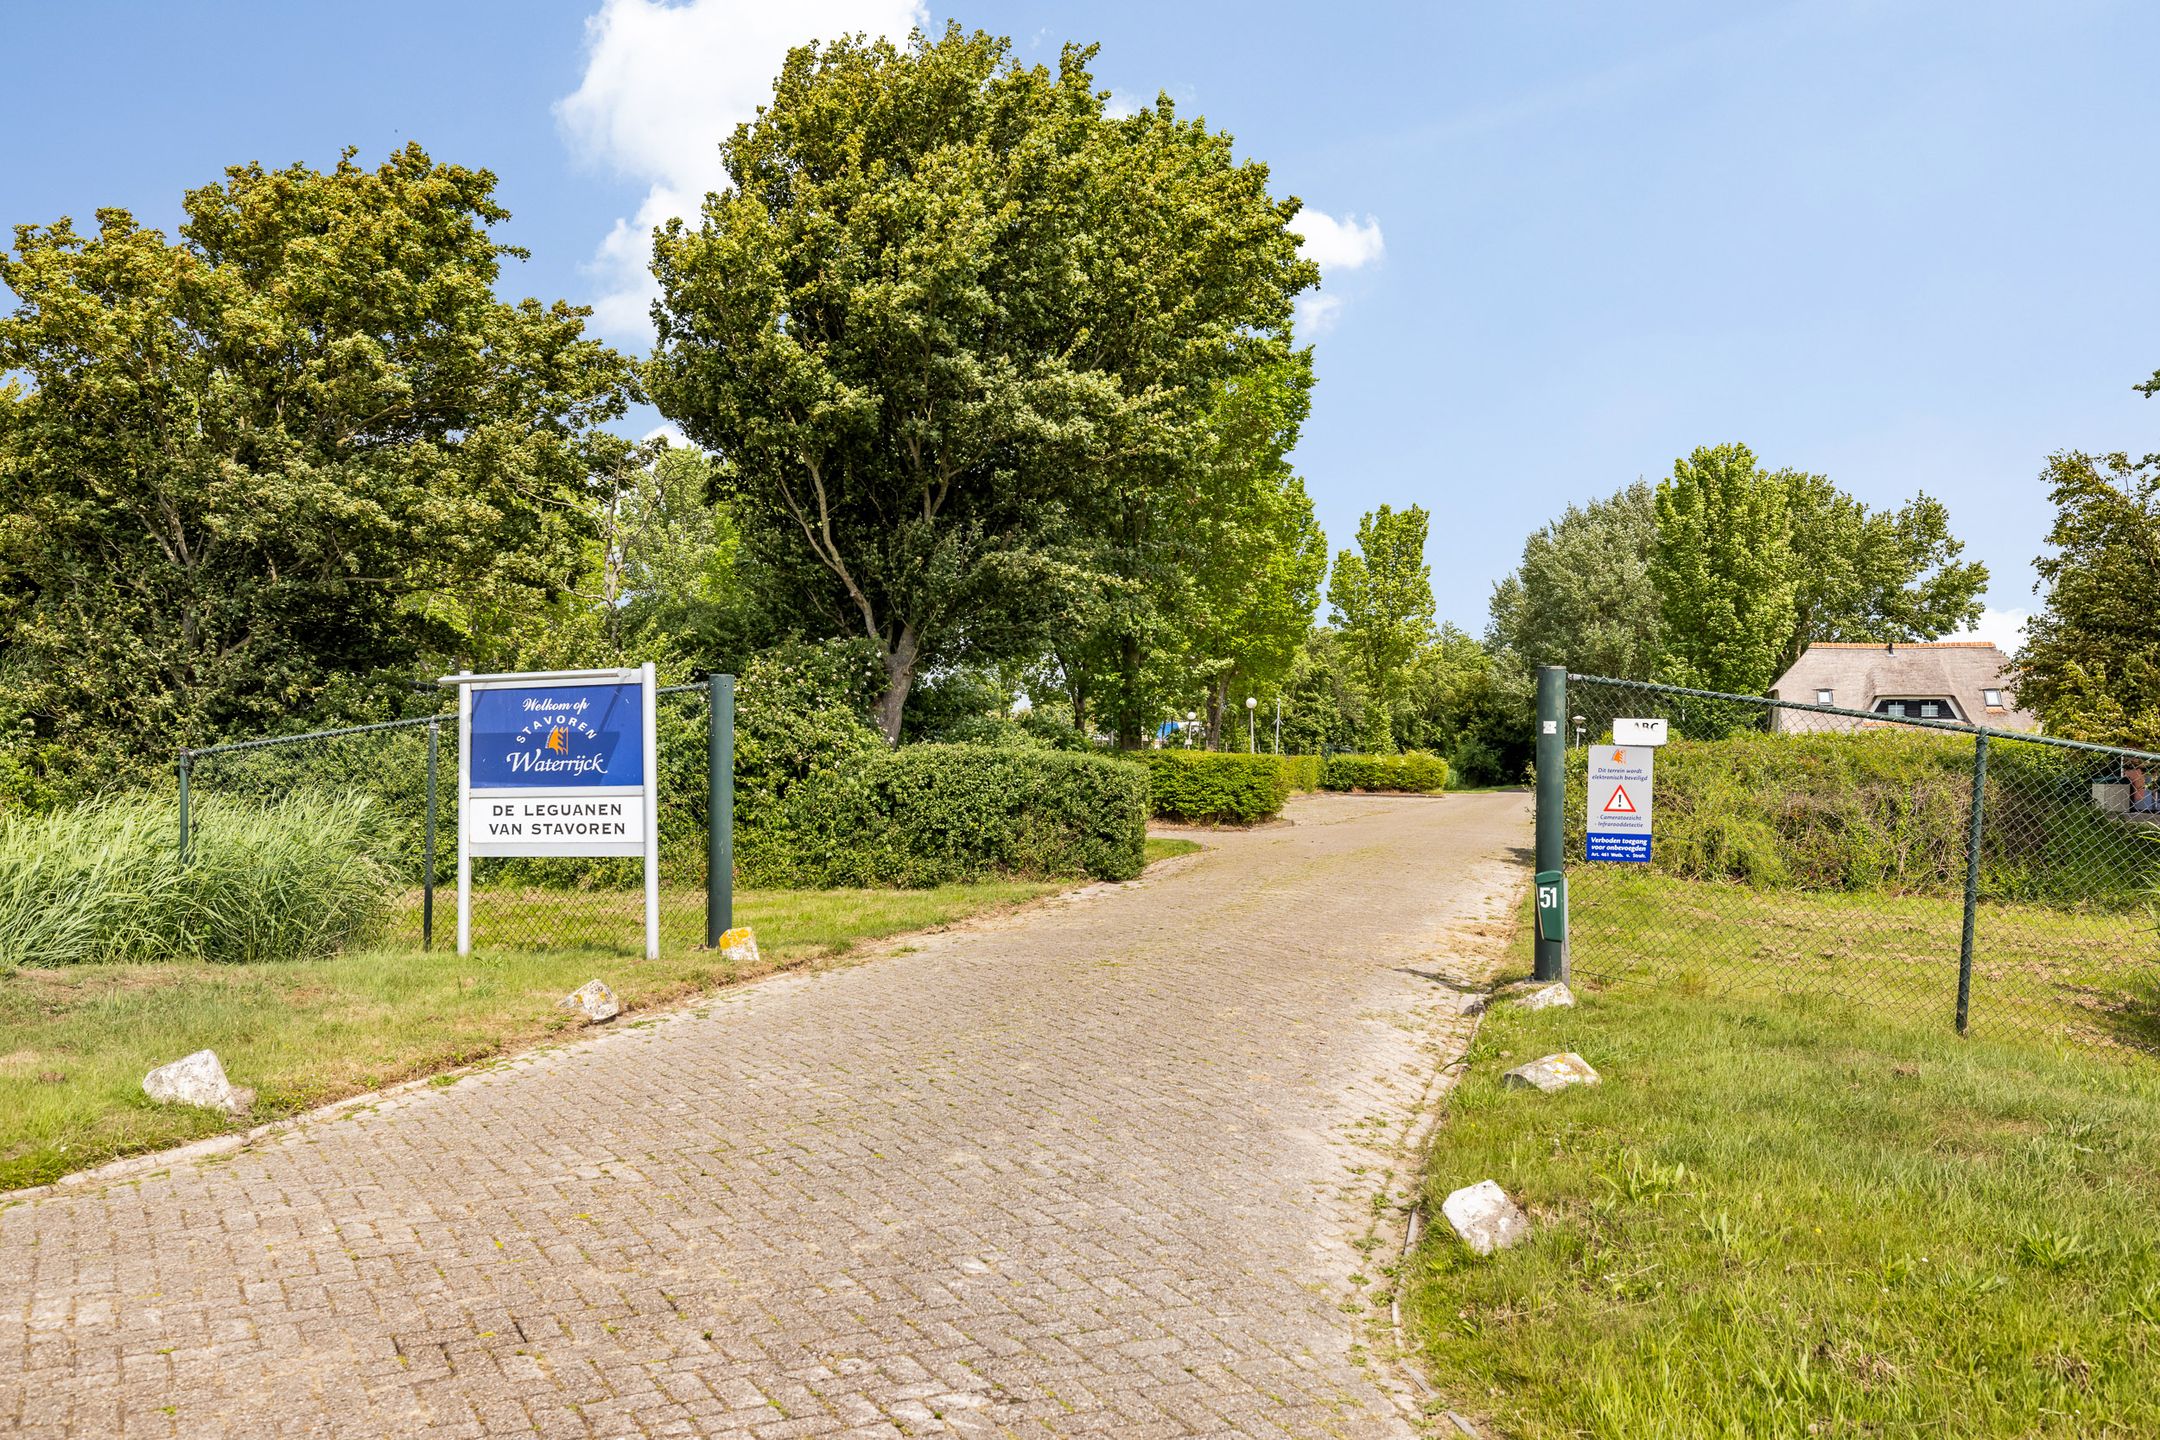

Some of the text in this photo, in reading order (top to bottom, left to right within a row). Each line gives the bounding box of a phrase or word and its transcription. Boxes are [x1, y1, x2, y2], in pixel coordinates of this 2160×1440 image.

[523, 698, 590, 714] Welkom op
[516, 716, 596, 744] STAVOREN
[506, 749, 608, 776] Waterrijck
[493, 804, 622, 816] DE LEGUANEN
[489, 823, 625, 835] VAN STAVOREN
[1540, 887, 1557, 908] 51
